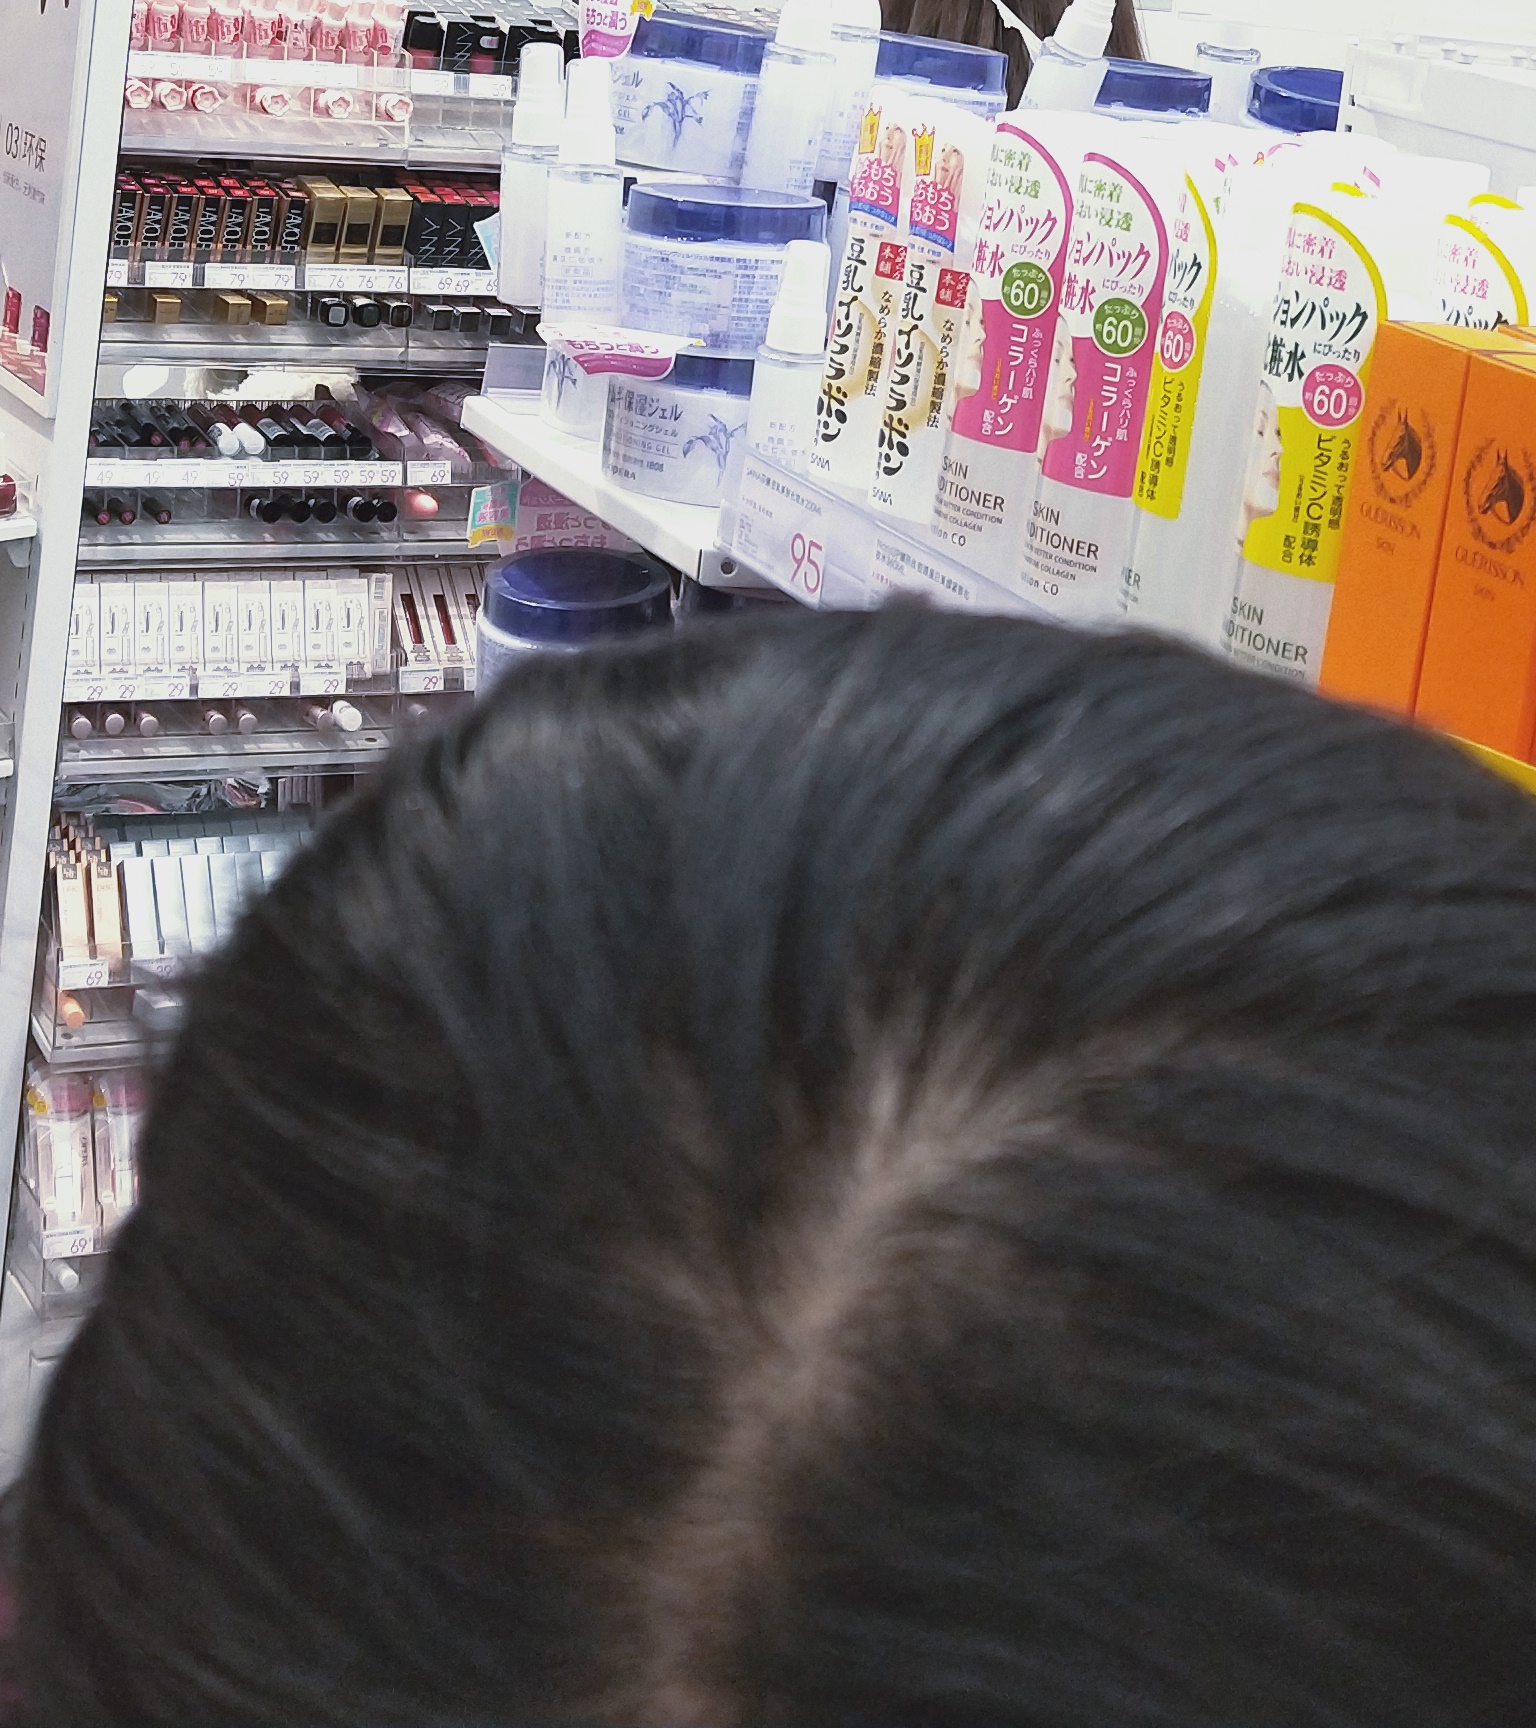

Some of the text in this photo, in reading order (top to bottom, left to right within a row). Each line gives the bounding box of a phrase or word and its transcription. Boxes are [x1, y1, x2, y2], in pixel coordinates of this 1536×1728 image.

[5, 122, 20, 159] 03
[22, 130, 47, 172] 环保
[972, 238, 1005, 278] 粧水
[1011, 280, 1039, 310] 60
[1061, 273, 1097, 315] 粧水
[1102, 316, 1133, 348] 60
[1163, 330, 1184, 363] 60
[1264, 333, 1307, 383] 粧水
[981, 324, 1029, 436] コラーゲン 配合
[1074, 362, 1122, 480] コラーゲン 配合
[1313, 385, 1347, 419] 60
[942, 455, 969, 480] SKIN
[938, 480, 1005, 513] DITIONER
[1032, 500, 1061, 527] SKIN
[1027, 523, 1100, 561] DITIONER
[790, 532, 824, 595] 95
[1231, 596, 1264, 626] SKIN
[1227, 620, 1308, 665] DITIONER
